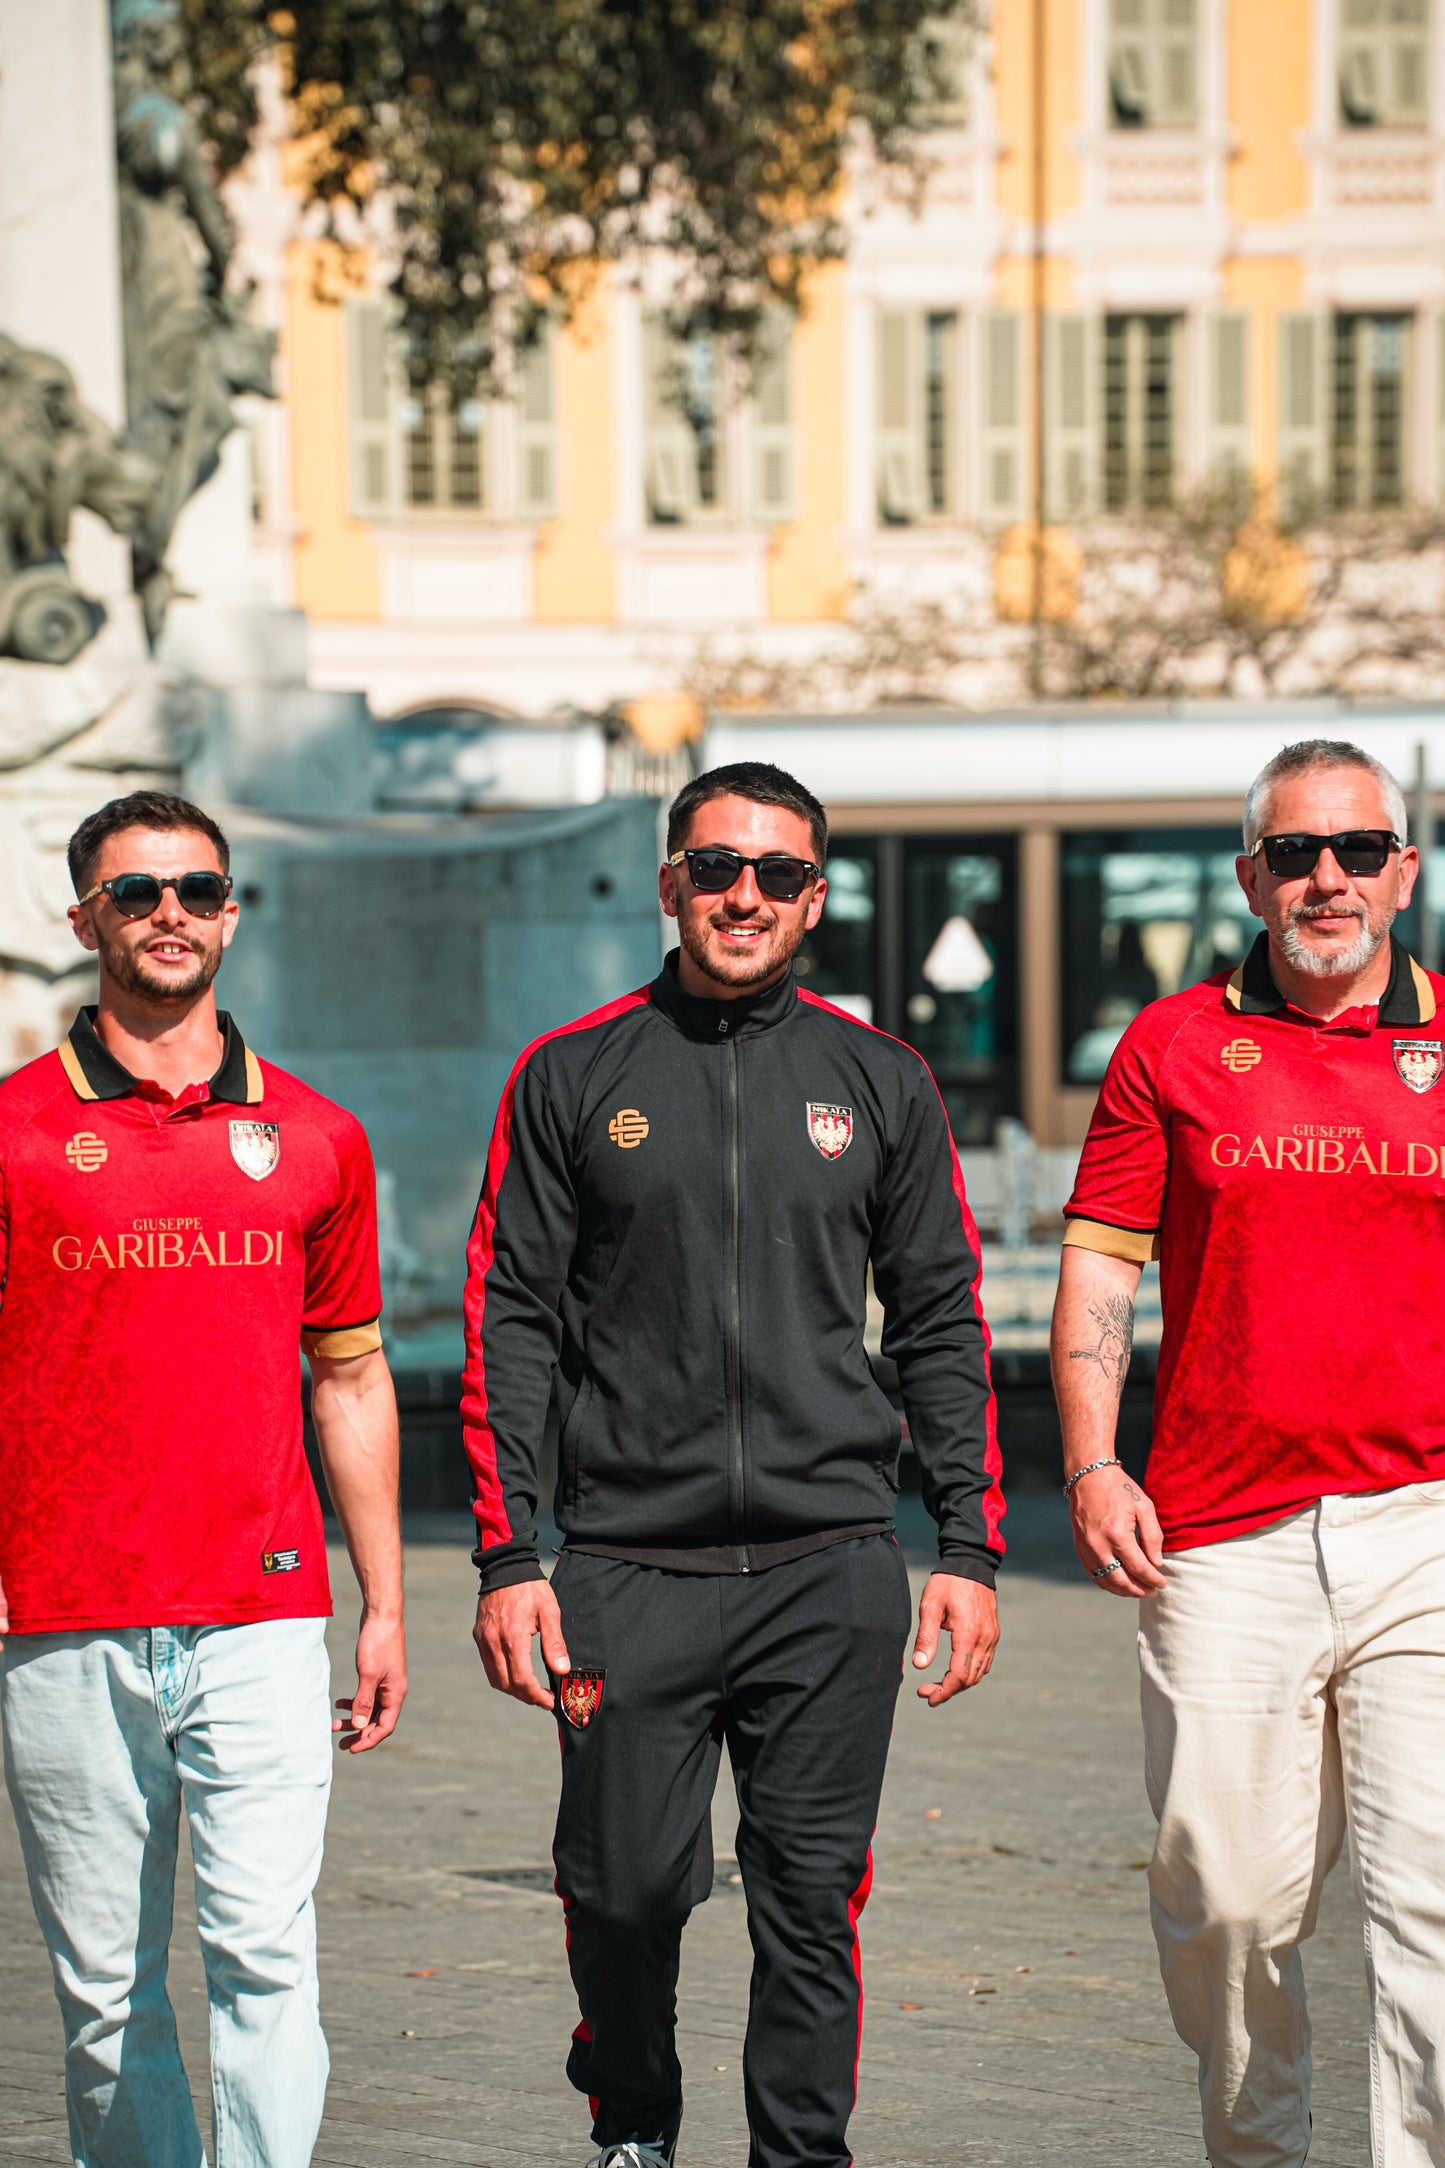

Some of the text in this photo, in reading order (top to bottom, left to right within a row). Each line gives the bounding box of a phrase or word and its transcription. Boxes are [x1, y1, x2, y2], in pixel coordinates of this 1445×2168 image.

[1292, 1124, 1366, 1139] GIUSEPPE
[132, 1217, 204, 1232] GIUSEPPE
[52, 1230, 284, 1271] GARIBALDI
